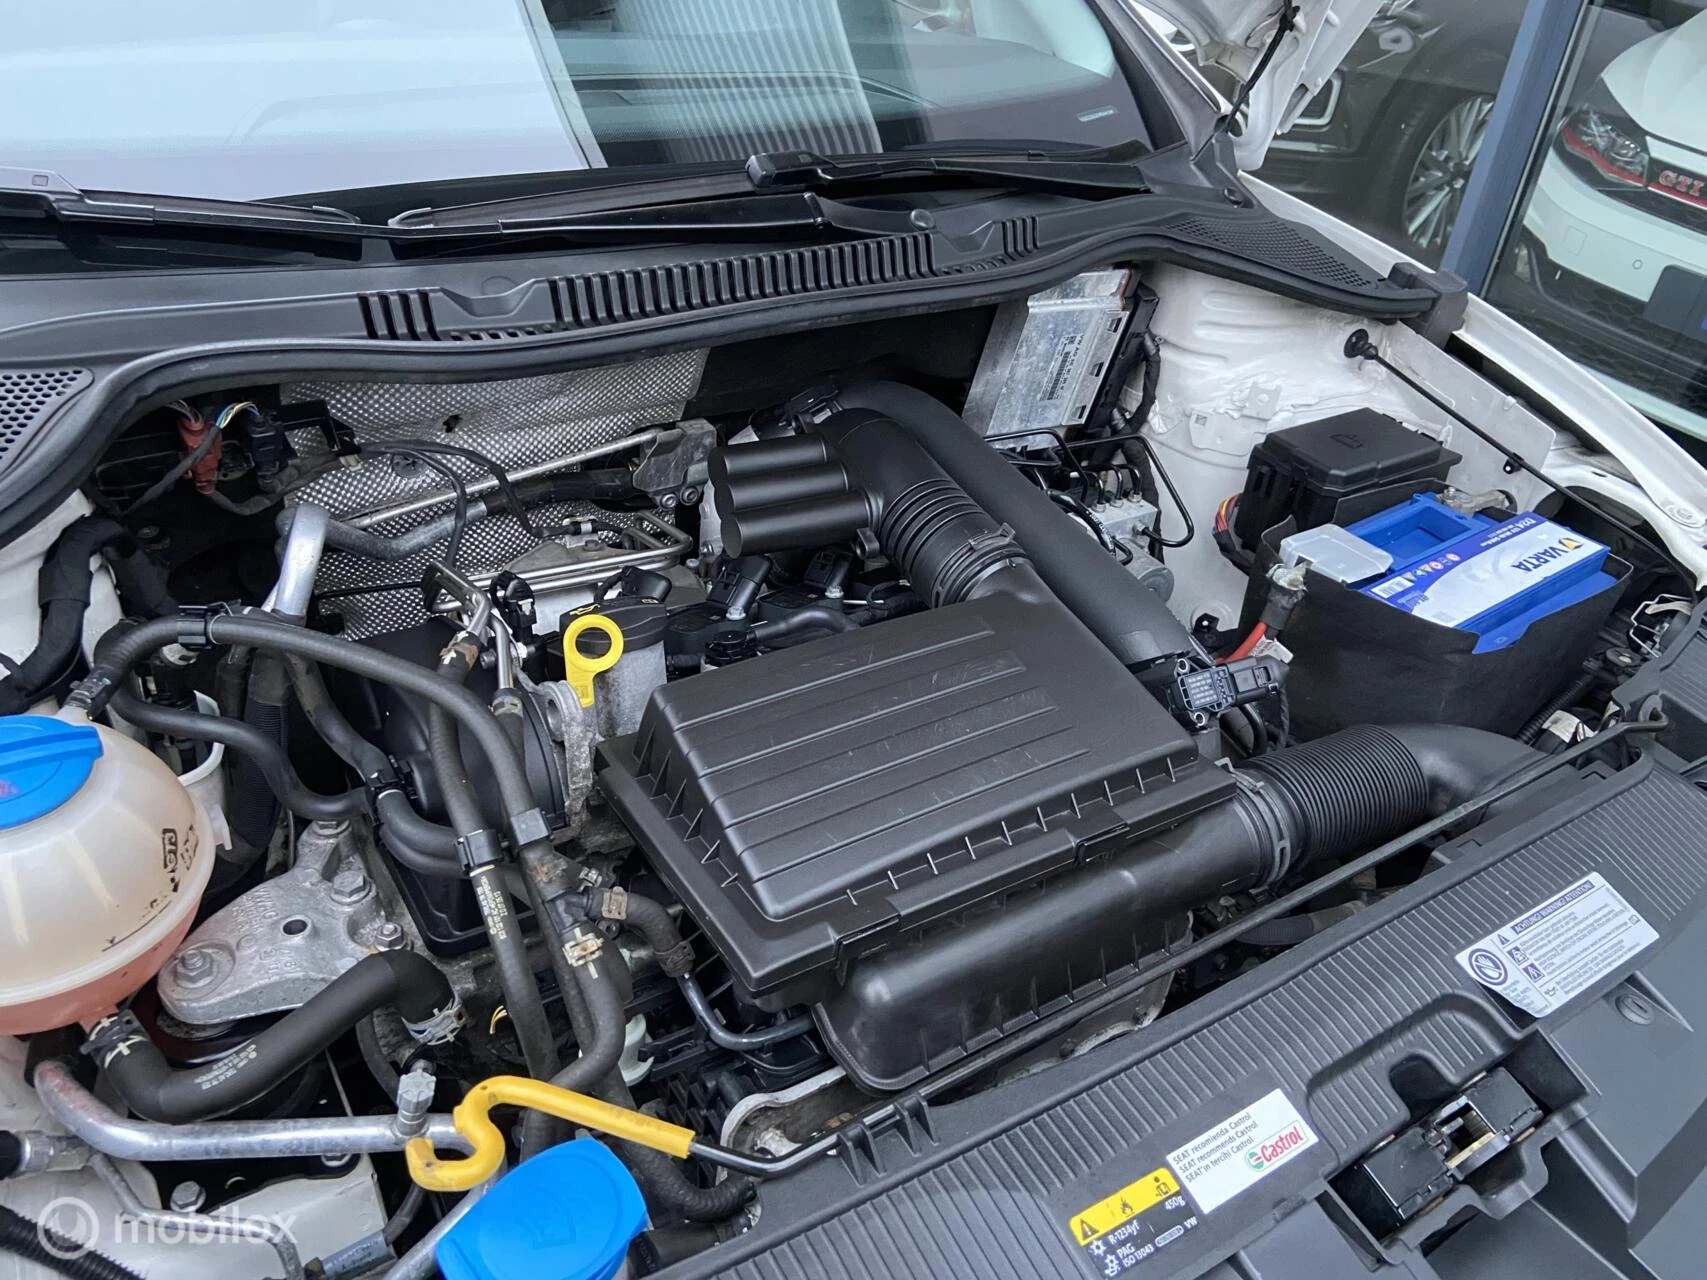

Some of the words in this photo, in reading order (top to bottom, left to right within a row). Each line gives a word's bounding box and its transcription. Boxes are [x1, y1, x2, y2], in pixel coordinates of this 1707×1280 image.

[1659, 170, 1705, 197] GTI
[1511, 546, 1568, 572] VARTA
[1173, 1150, 1190, 1165] SEAT
[1191, 1127, 1229, 1154] recomienda
[1229, 1112, 1252, 1129] Castrol
[1179, 1159, 1196, 1173] SEAT
[1197, 1135, 1236, 1163] recommends
[1235, 1121, 1258, 1138] Castrol
[1231, 1136, 1254, 1153] Castrol
[1261, 1125, 1304, 1163] Castrol
[1108, 1219, 1139, 1244] R-1234yf
[1165, 1196, 1186, 1209] 450g
[1117, 1243, 1135, 1259] PAG
[1122, 1255, 1136, 1267] ISO
[1184, 1216, 1198, 1229] VW
